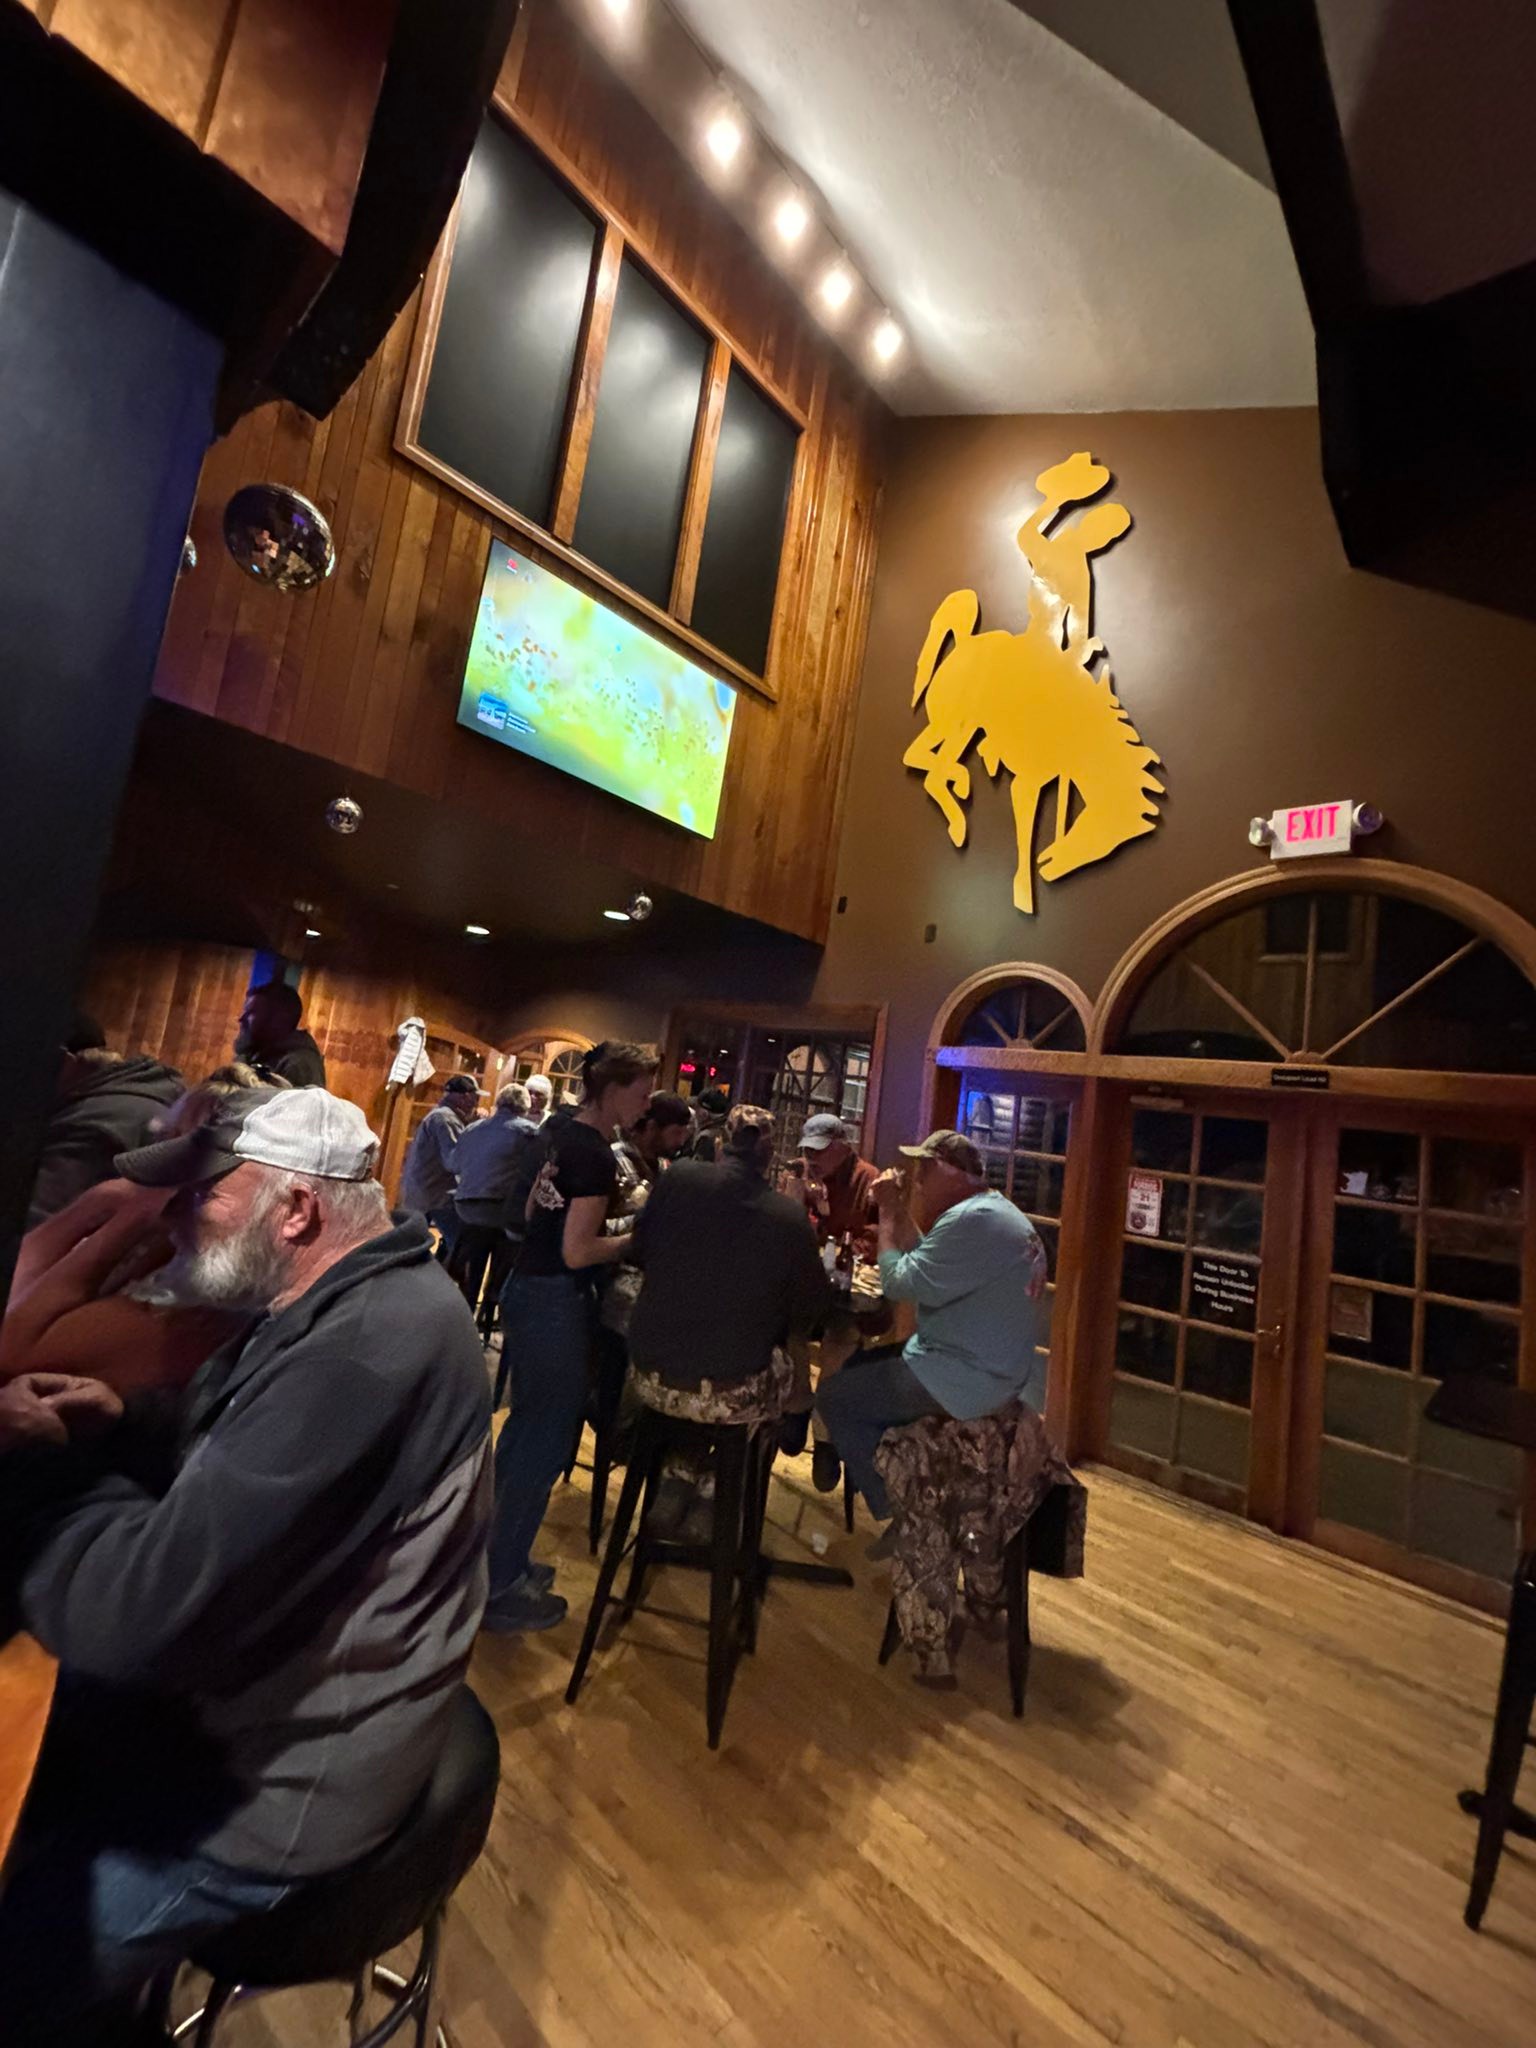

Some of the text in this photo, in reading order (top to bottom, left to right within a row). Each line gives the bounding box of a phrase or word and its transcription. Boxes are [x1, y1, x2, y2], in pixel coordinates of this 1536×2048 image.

[1286, 805, 1340, 842] EXIT
[1203, 1261, 1249, 1278] This Door To
[1193, 1272, 1256, 1292] Remain Unlocked
[1194, 1284, 1254, 1304] During Business
[1211, 1301, 1233, 1312] Hours
